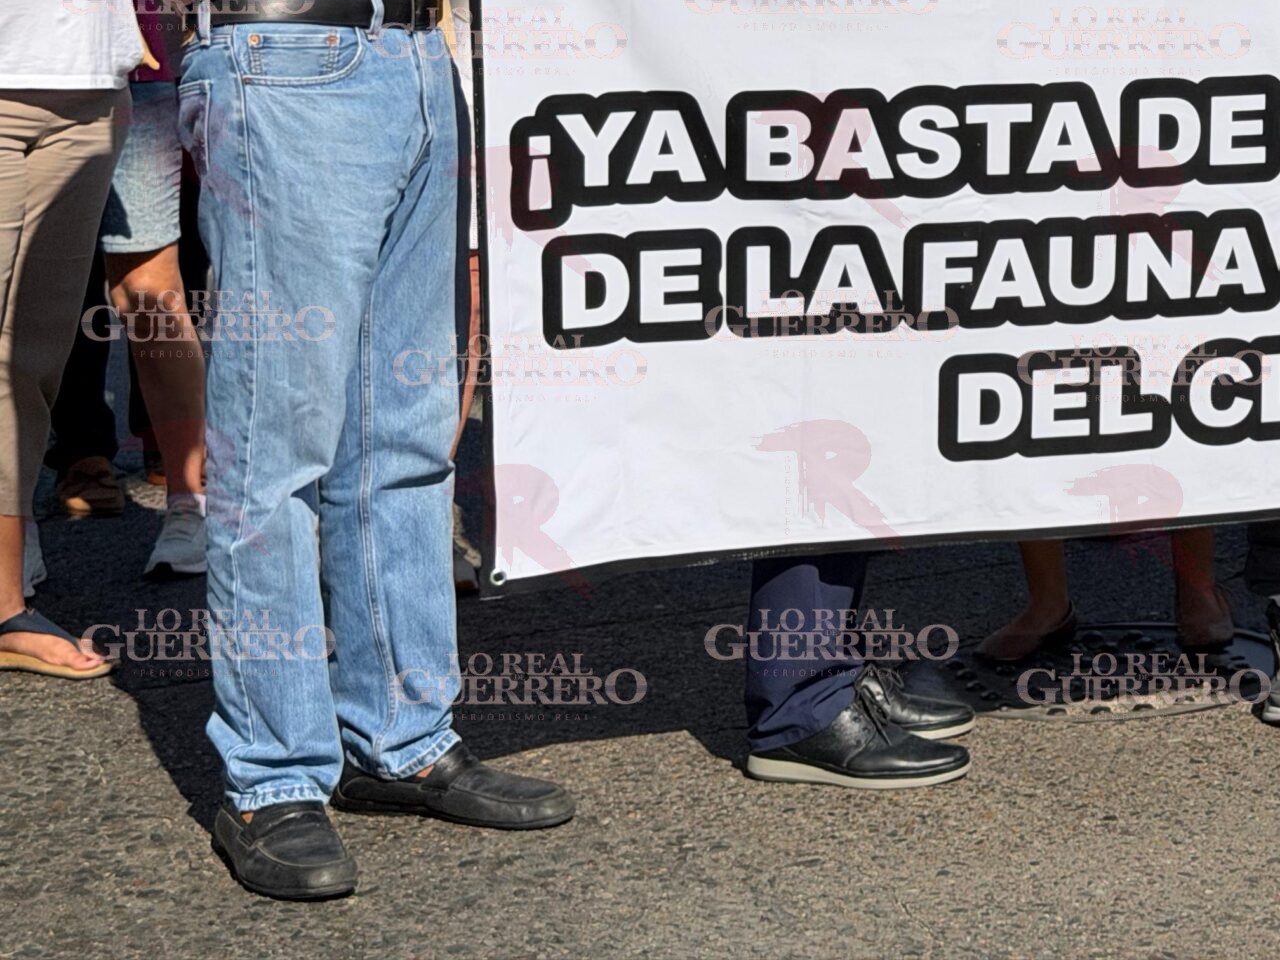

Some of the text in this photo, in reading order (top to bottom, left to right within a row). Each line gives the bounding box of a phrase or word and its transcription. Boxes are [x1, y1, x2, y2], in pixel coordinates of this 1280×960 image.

[526, 106, 708, 213] ¡YA
[743, 98, 1104, 185] BASTA
[1135, 91, 1269, 172] DE
[558, 245, 704, 332] DE
[743, 241, 886, 320] LA
[919, 224, 1269, 315] FAUNA
[954, 362, 1156, 446] DEL
